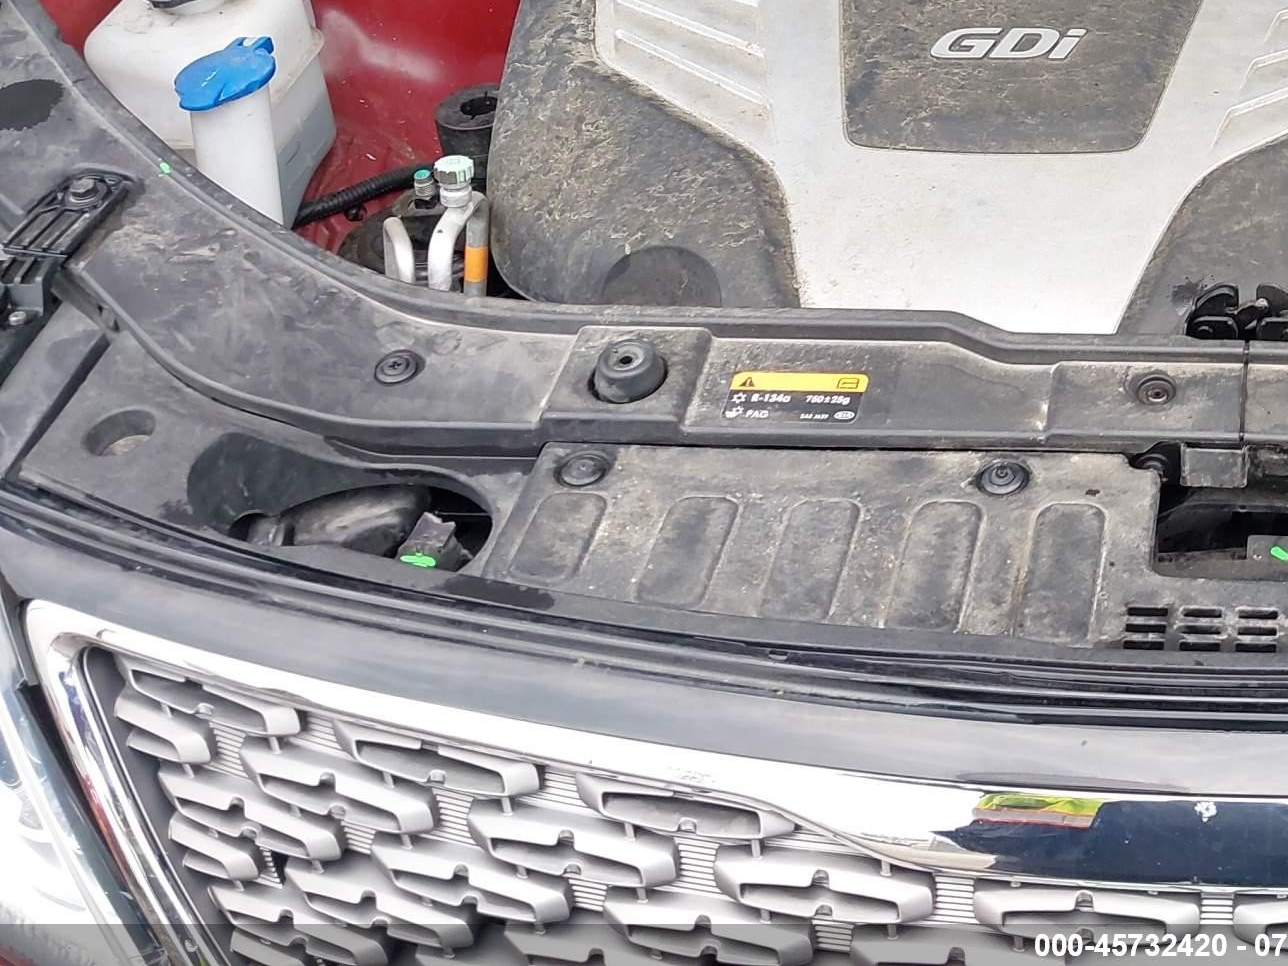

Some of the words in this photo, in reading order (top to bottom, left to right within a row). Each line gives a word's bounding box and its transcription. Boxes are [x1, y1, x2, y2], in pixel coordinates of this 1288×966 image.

[930, 27, 1088, 60] GDi
[750, 393, 792, 404] R-134a
[745, 409, 769, 419] PAG
